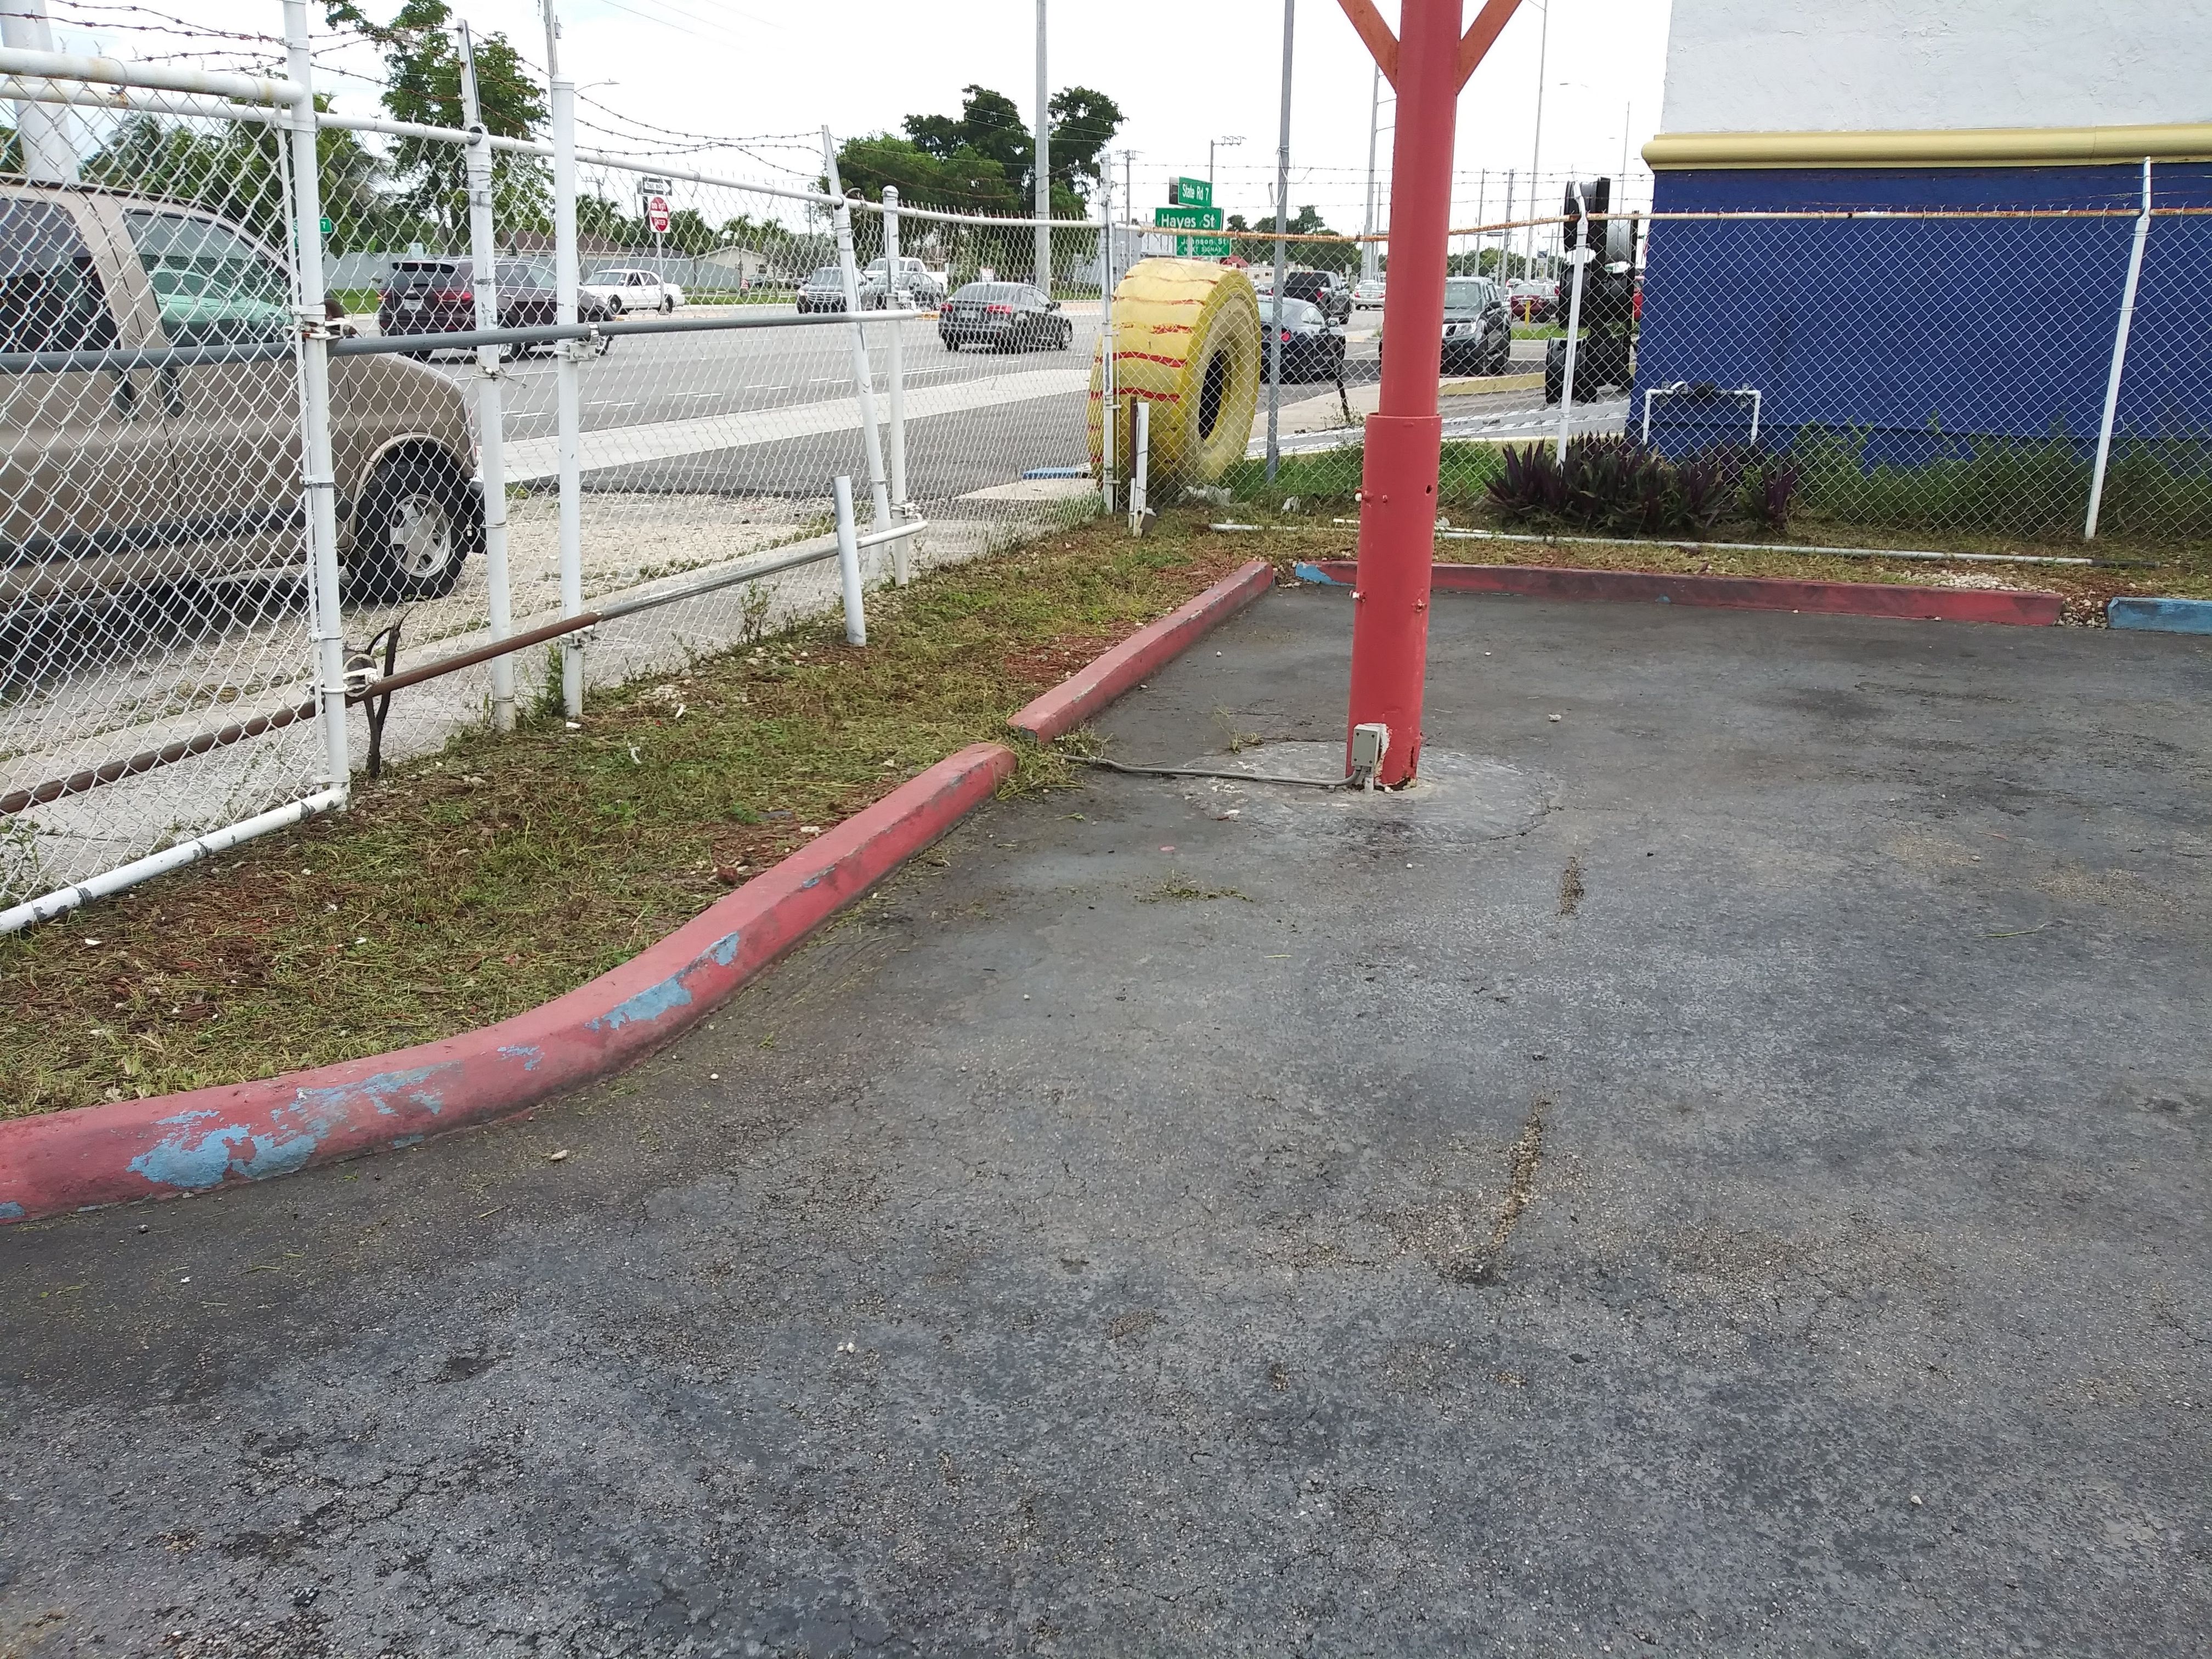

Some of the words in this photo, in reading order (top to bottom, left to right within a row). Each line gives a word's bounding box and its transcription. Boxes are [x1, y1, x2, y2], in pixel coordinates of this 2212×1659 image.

[1182, 183, 1195, 199] State
[1197, 185, 1204, 201] Rd
[1205, 187, 1209, 201] 7
[1161, 213, 1196, 229] Hayes
[1203, 213, 1215, 228] St
